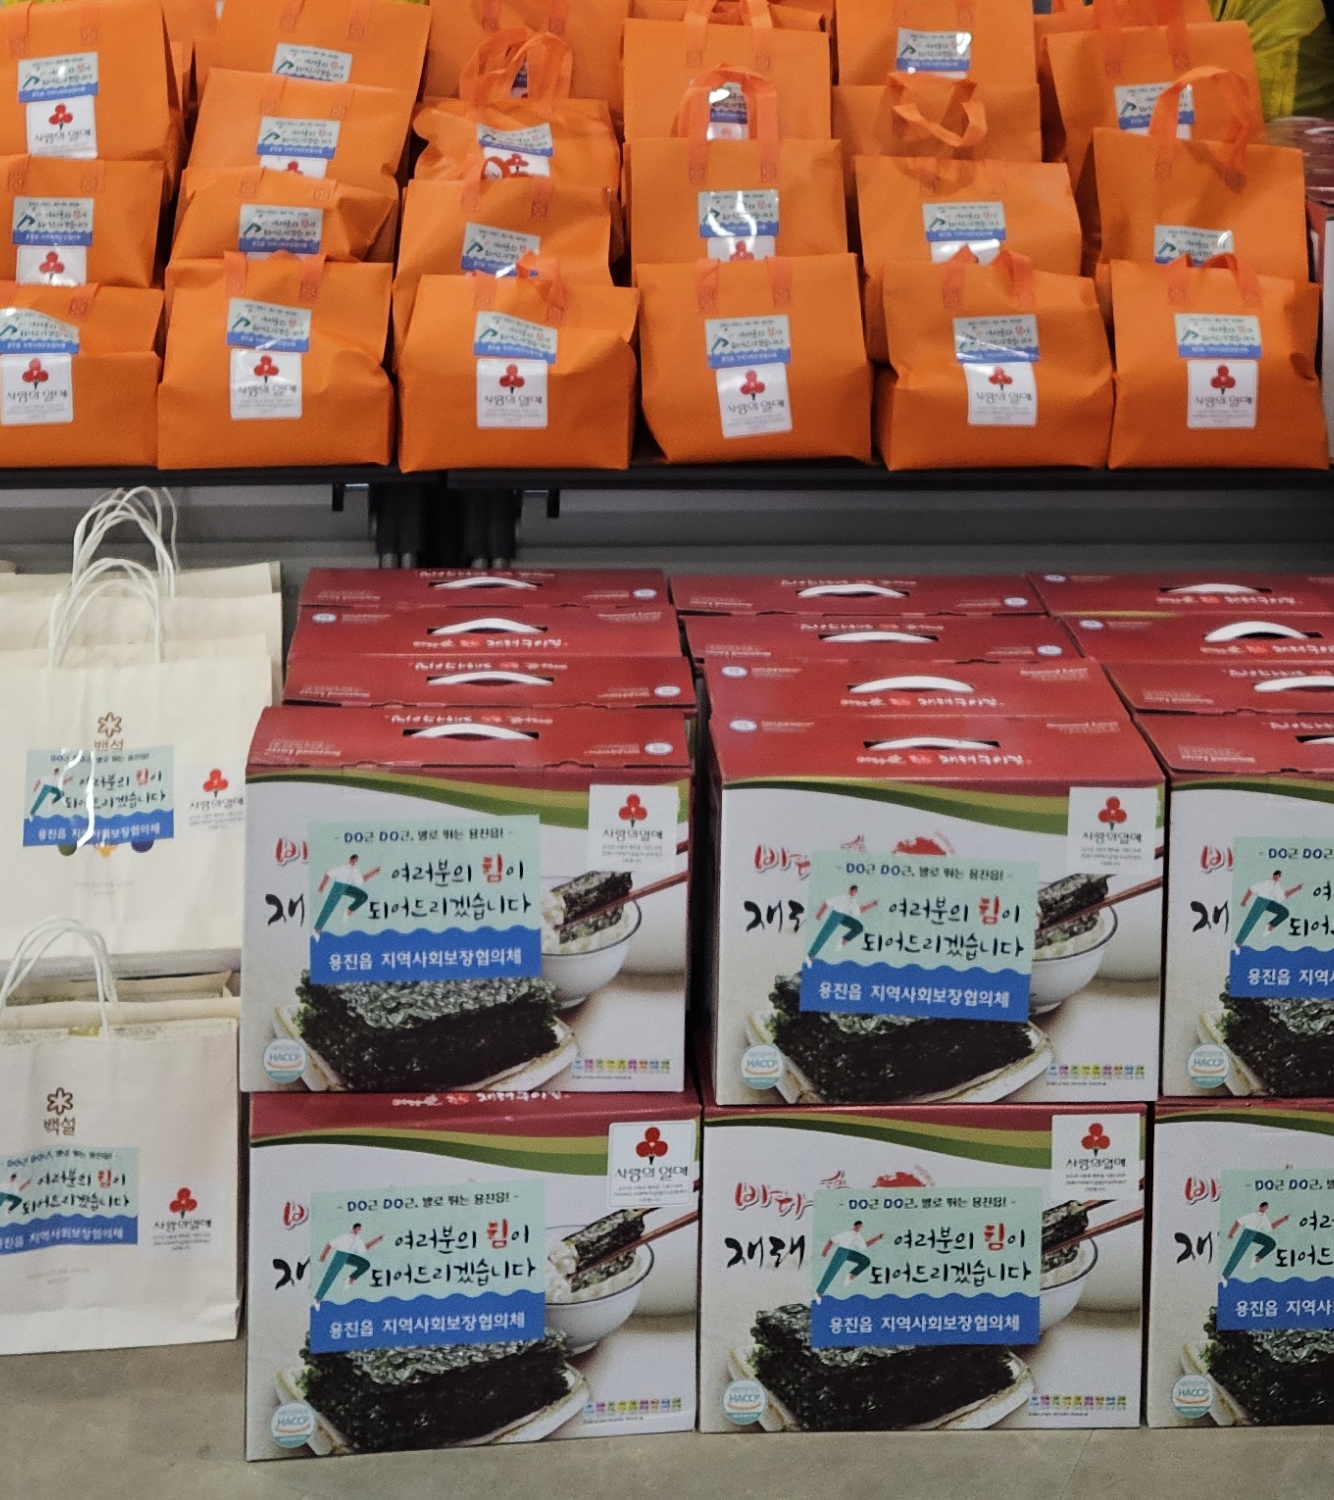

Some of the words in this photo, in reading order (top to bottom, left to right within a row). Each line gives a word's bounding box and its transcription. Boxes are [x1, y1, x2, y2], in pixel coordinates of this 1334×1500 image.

[391, 859, 473, 888] 여러분의
[481, 853, 524, 883] 힘이
[366, 891, 533, 922] 되어드리겠습니다
[888, 893, 970, 927] 여러분의
[977, 894, 1021, 926] 힘이
[861, 925, 1026, 965] 되어드리겠습니다
[328, 953, 373, 971] 용진읍
[380, 948, 521, 969] 지역사회보장협의체
[1247, 969, 1291, 986] 용진읍
[818, 982, 863, 1001] 용진읍
[869, 985, 1009, 1008] 지역사회보장협의체
[43, 1115, 76, 1137] 백설
[394, 1224, 477, 1255] 여러분의
[486, 1217, 529, 1248] 힘이
[894, 1226, 974, 1254] 여러분의
[983, 1222, 1025, 1250] 힘이
[369, 1255, 537, 1290] 되어드리겠습니다
[869, 1259, 1032, 1287] 되어드리겠습니다
[1235, 1300, 1278, 1318] 용진읍
[329, 1320, 374, 1339] 용진읍
[382, 1312, 524, 1336] 지역사회보장협의체
[829, 1317, 873, 1333] 용진읍
[880, 1315, 1019, 1333] 지역사회보장협의체
